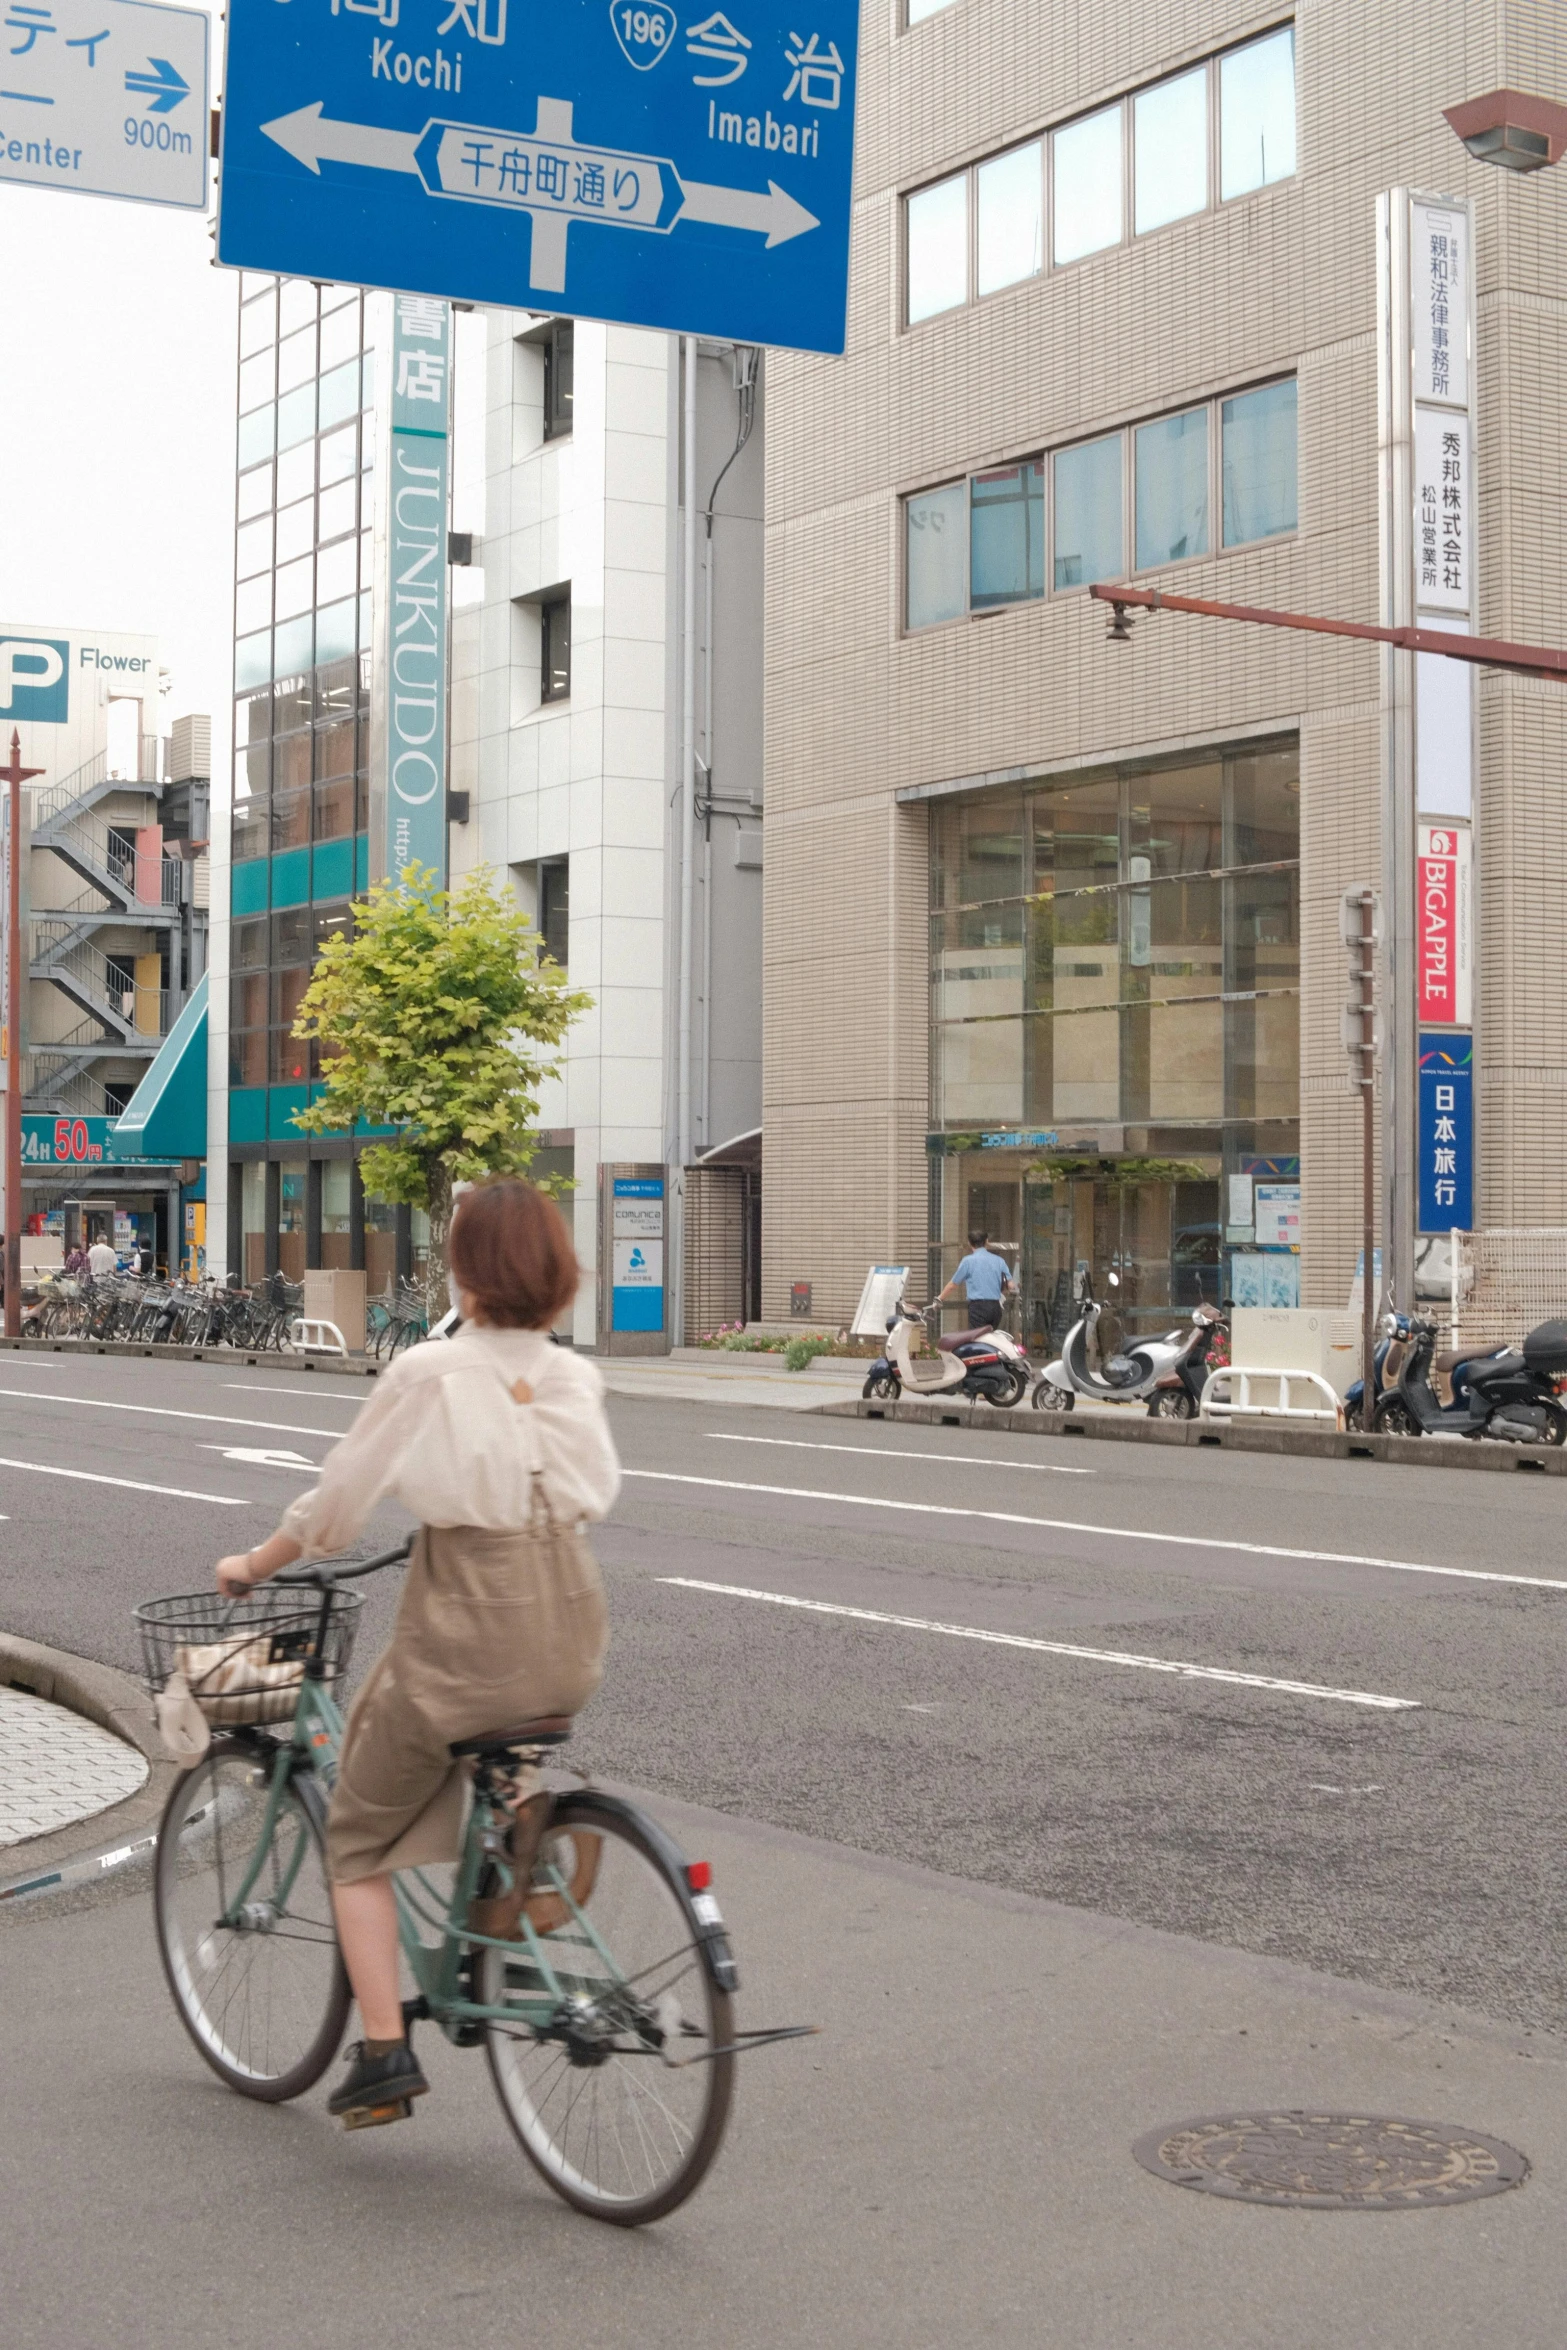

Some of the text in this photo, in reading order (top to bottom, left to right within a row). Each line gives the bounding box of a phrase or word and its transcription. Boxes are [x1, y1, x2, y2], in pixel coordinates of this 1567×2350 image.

[621, 9, 667, 47] 196
[686, 11, 845, 110] 今治
[371, 37, 462, 93] Kochi
[124, 117, 192, 154] 900m
[708, 100, 819, 158] Imabari
[461, 142, 640, 211] 千舟町通り
[395, 295, 446, 403] 書店
[1430, 233, 1450, 396] 親和法律事務所
[1421, 484, 1437, 587] 松山営業所
[1442, 432, 1462, 590] 秀邦株式会社
[80, 647, 152, 673] Flower
[393, 448, 440, 805] JUNKUDO
[0, 641, 64, 709] P
[54, 1119, 103, 1162] 50円
[1434, 1085, 1456, 1206] 日本旅行
